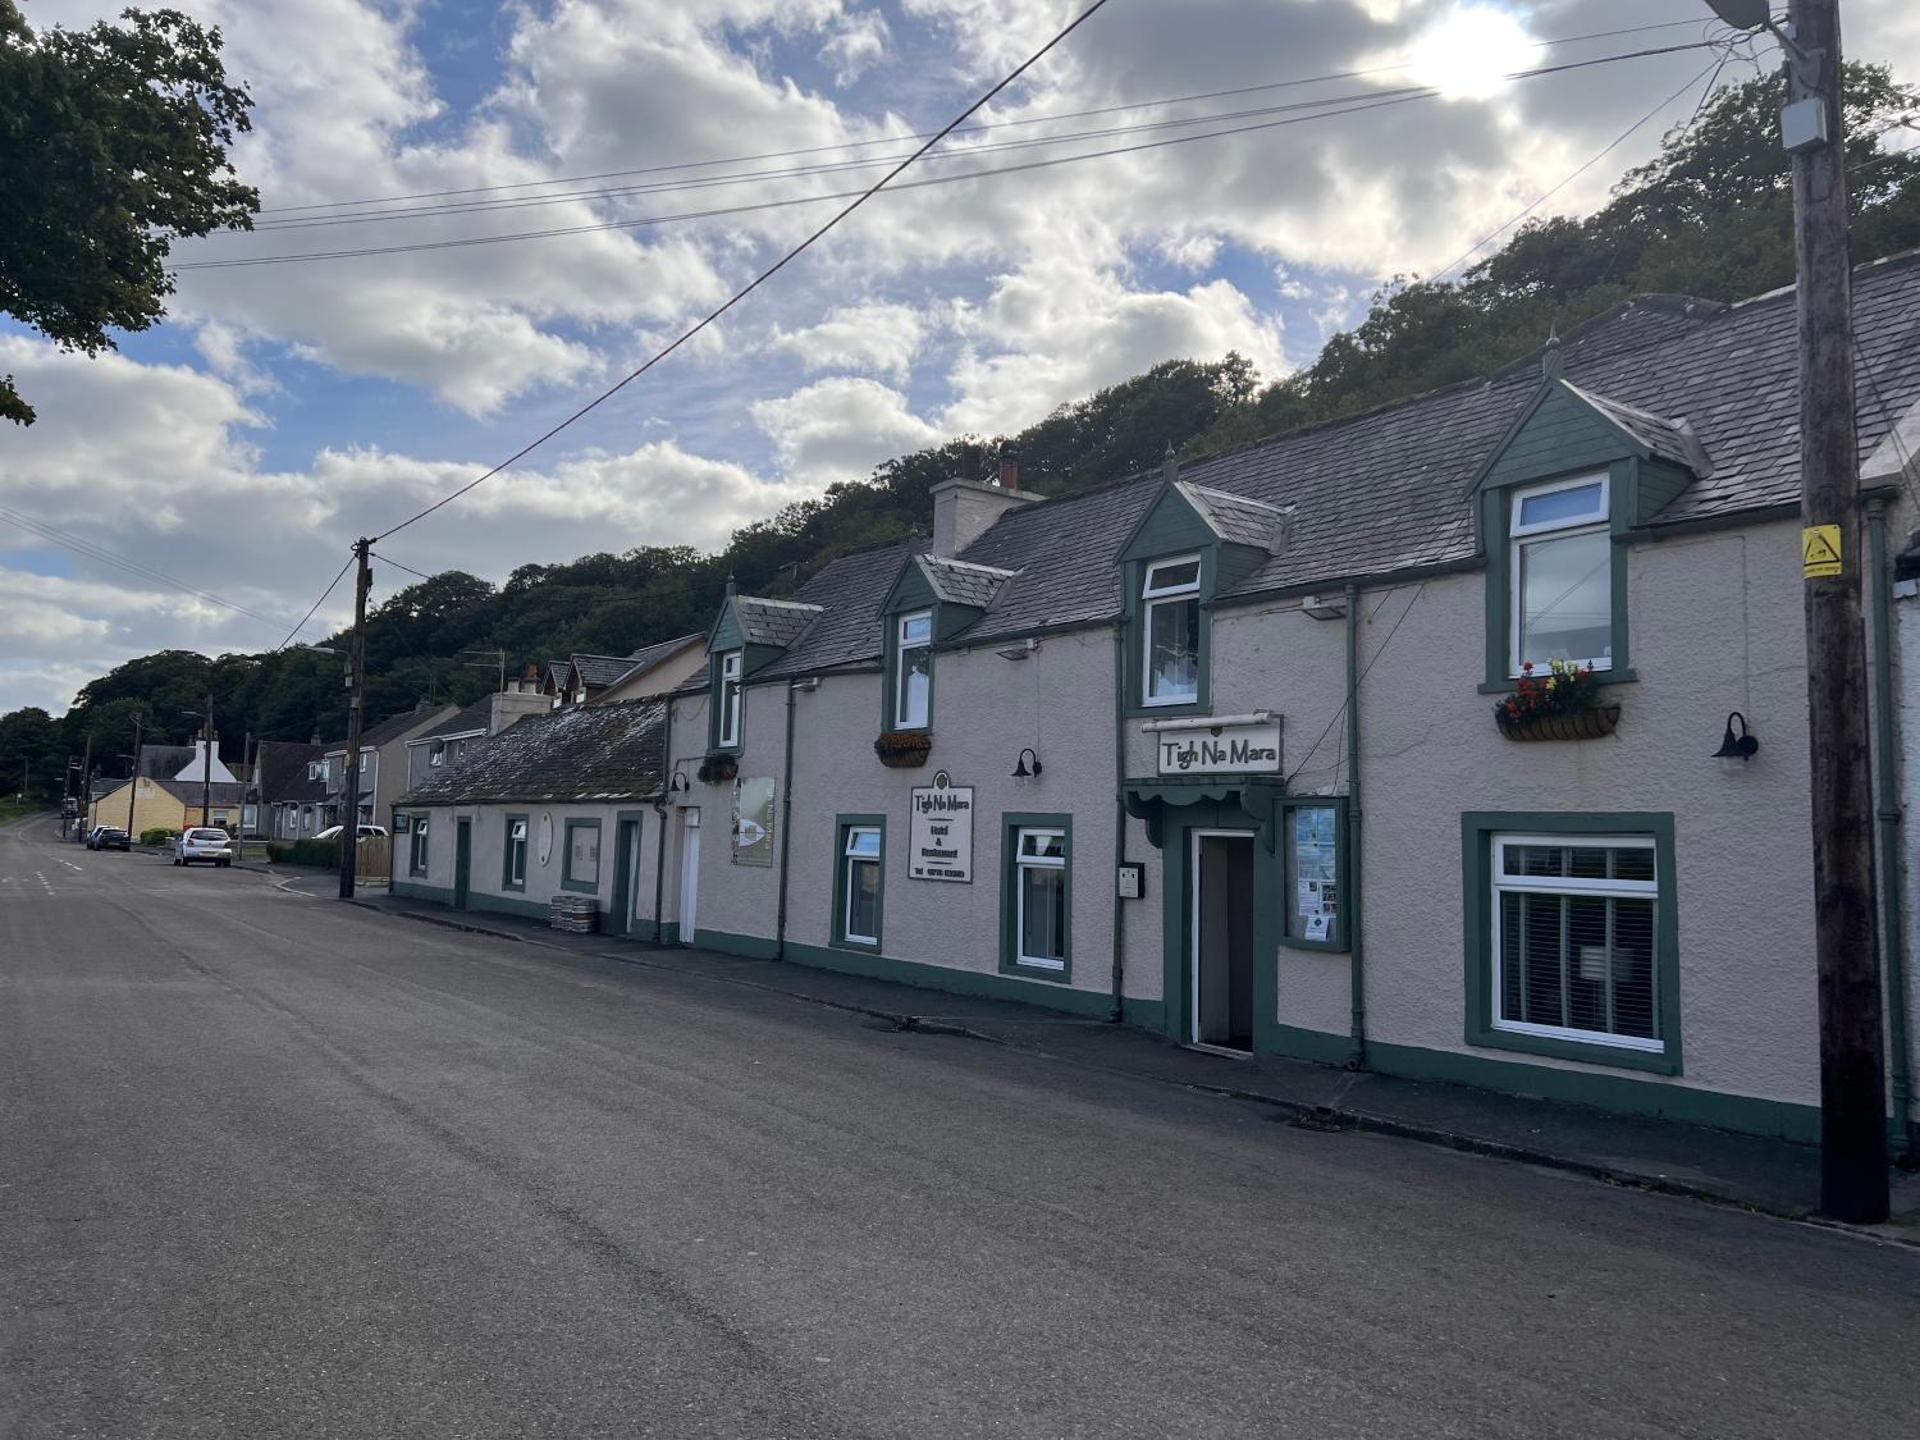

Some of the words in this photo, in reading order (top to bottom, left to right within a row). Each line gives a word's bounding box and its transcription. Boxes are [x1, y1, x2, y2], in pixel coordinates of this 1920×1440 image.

[1162, 741, 1198, 769] Tigh
[1201, 740, 1226, 765] Na
[1229, 739, 1276, 764] Mara
[914, 794, 932, 814] Tigh
[933, 794, 946, 811] Na
[947, 794, 969, 811] Mara
